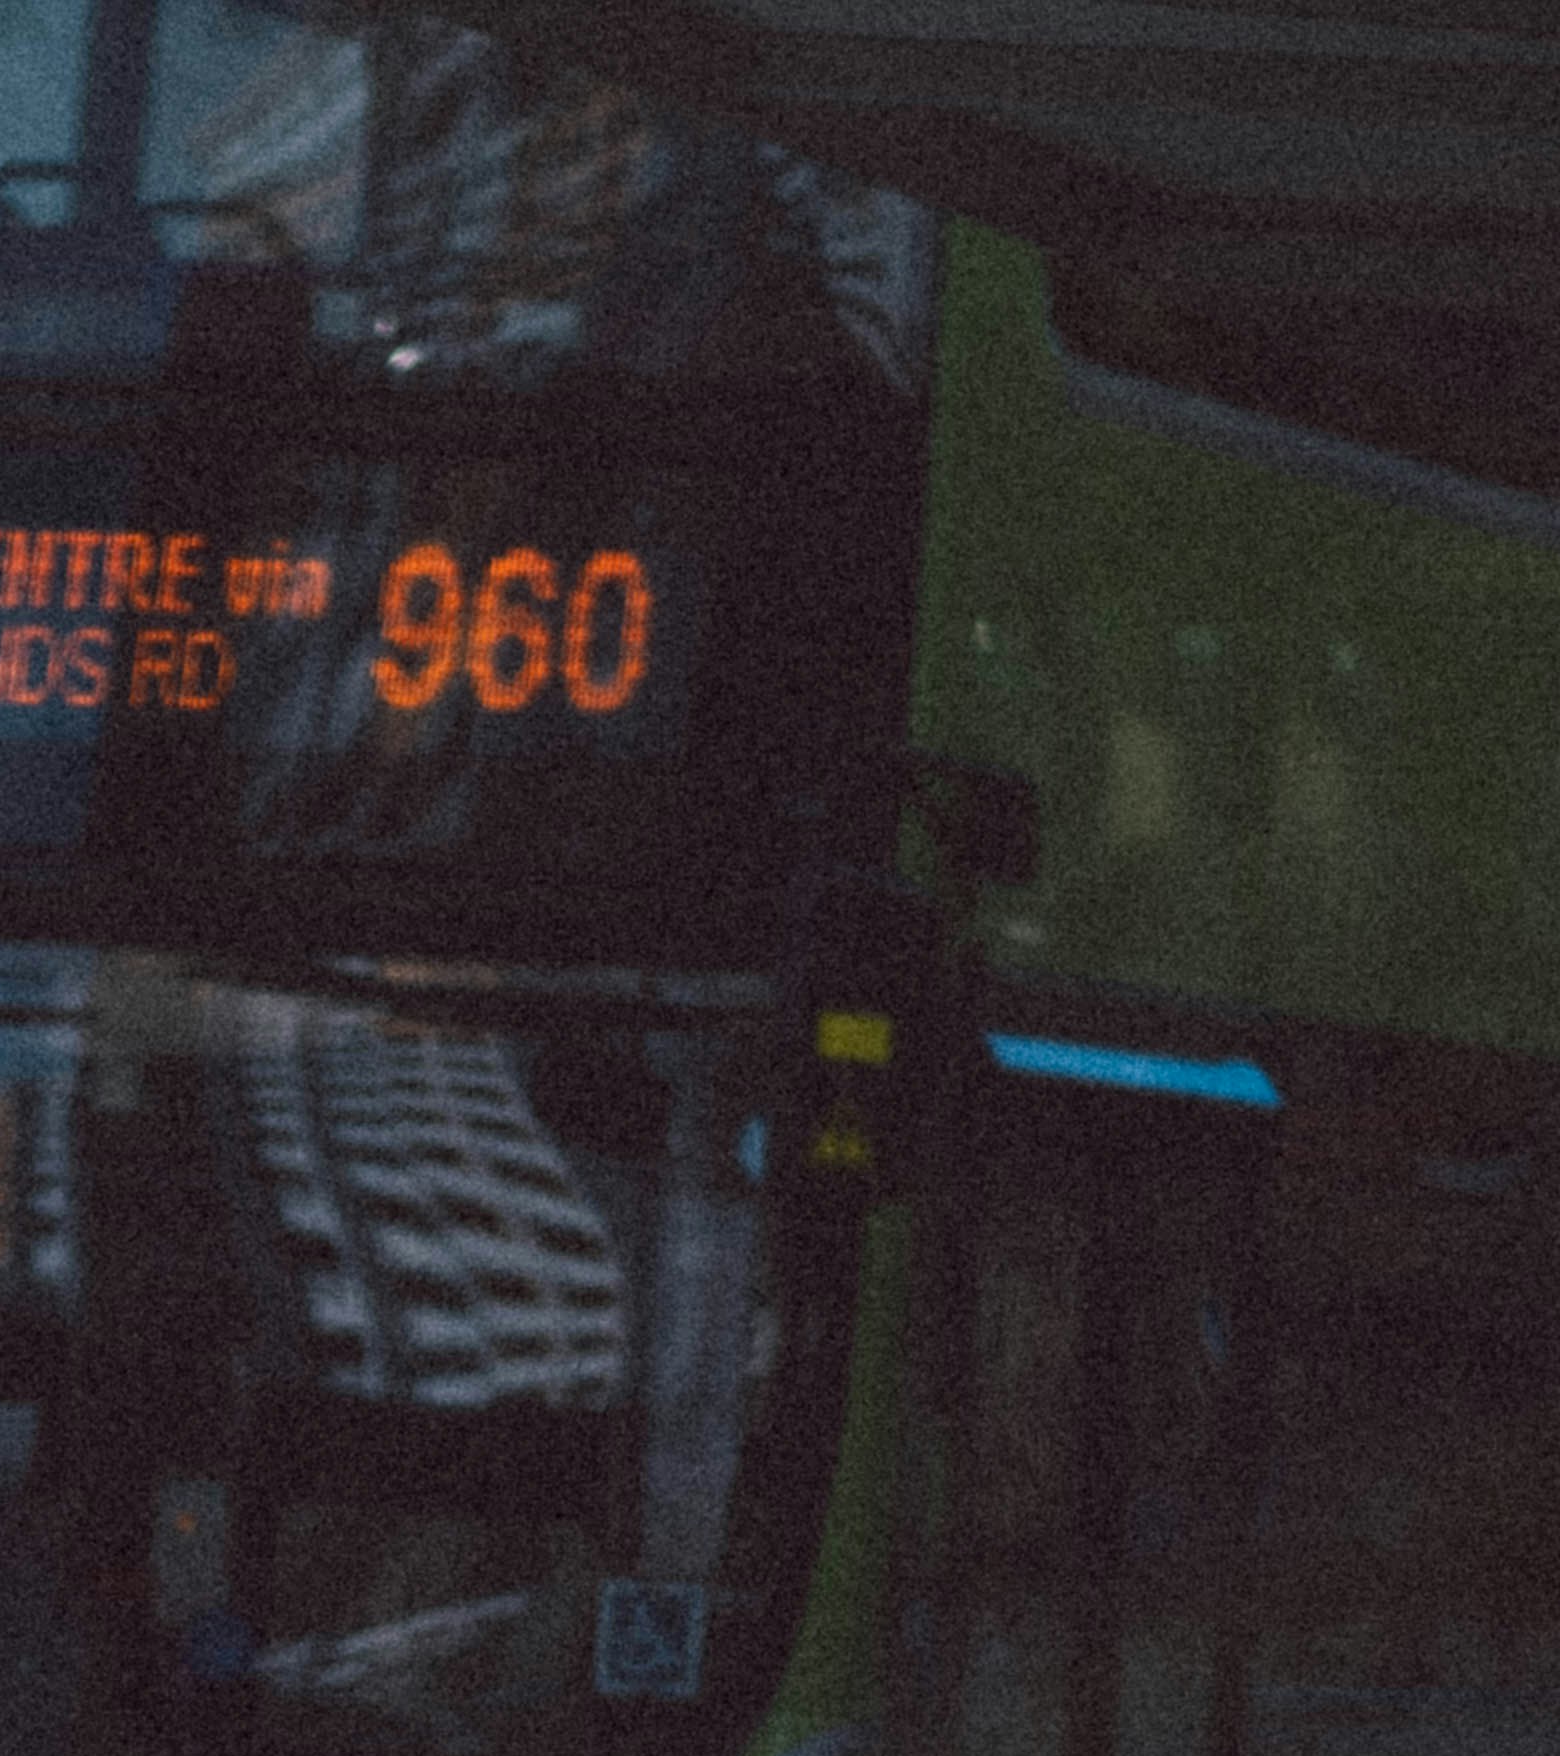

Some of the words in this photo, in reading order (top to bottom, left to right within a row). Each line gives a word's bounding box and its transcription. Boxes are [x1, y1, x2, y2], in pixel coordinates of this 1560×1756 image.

[224, 542, 331, 619] via
[369, 542, 655, 712] 960
[128, 628, 237, 709] RD
